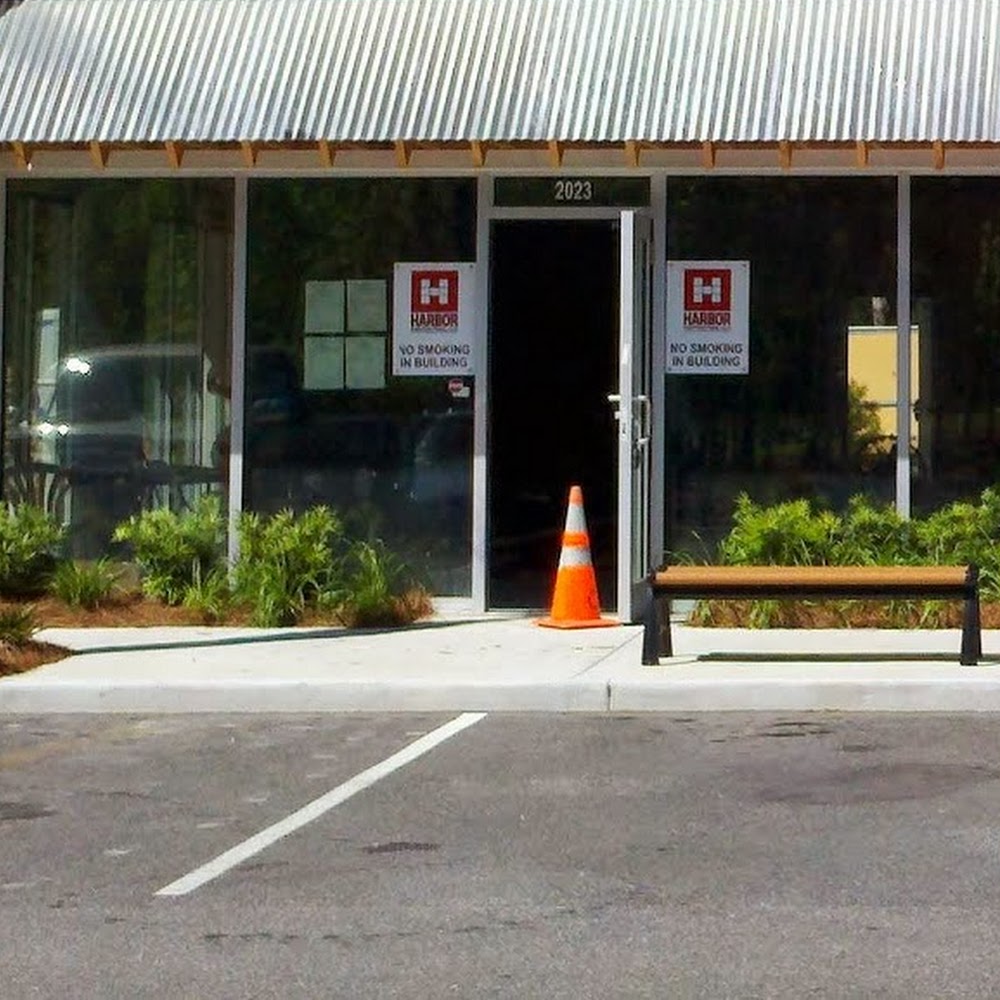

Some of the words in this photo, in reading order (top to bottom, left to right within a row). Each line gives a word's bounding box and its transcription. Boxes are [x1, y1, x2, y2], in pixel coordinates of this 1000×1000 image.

[554, 180, 593, 200] 2023
[410, 312, 459, 328] HARBOR
[683, 311, 731, 326] HARBOR
[398, 344, 415, 355] NO
[417, 343, 471, 355] SMOKING
[670, 343, 688, 354] NO
[690, 342, 744, 354] SMOKING
[400, 357, 412, 368] IN
[414, 356, 468, 368] BUILDING
[672, 355, 684, 367] IN
[686, 355, 741, 367] BUILDING
